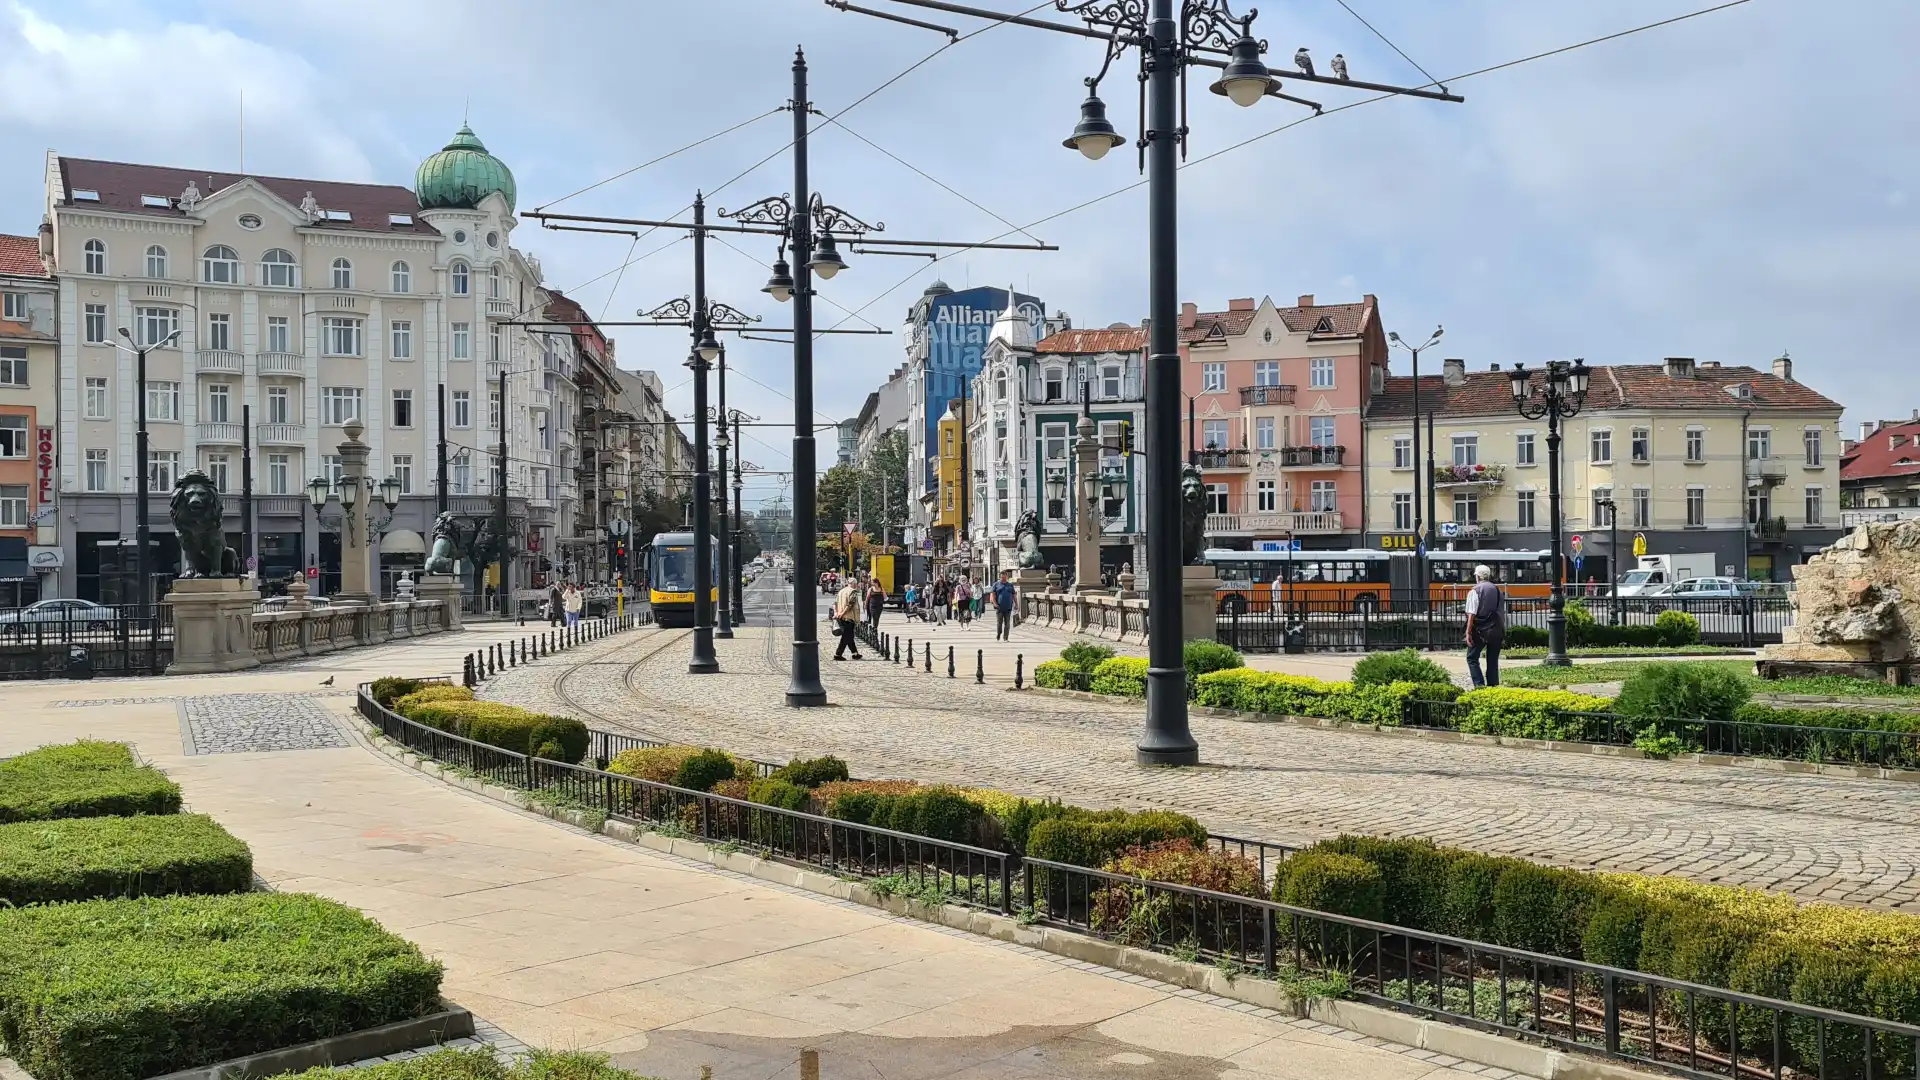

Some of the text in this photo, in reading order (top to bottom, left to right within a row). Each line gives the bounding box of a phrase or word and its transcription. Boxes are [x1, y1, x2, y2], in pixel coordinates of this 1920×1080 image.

[935, 305, 1005, 324] Allian
[38, 428, 52, 503] HOSTEL
[1381, 536, 1416, 548] BILL
